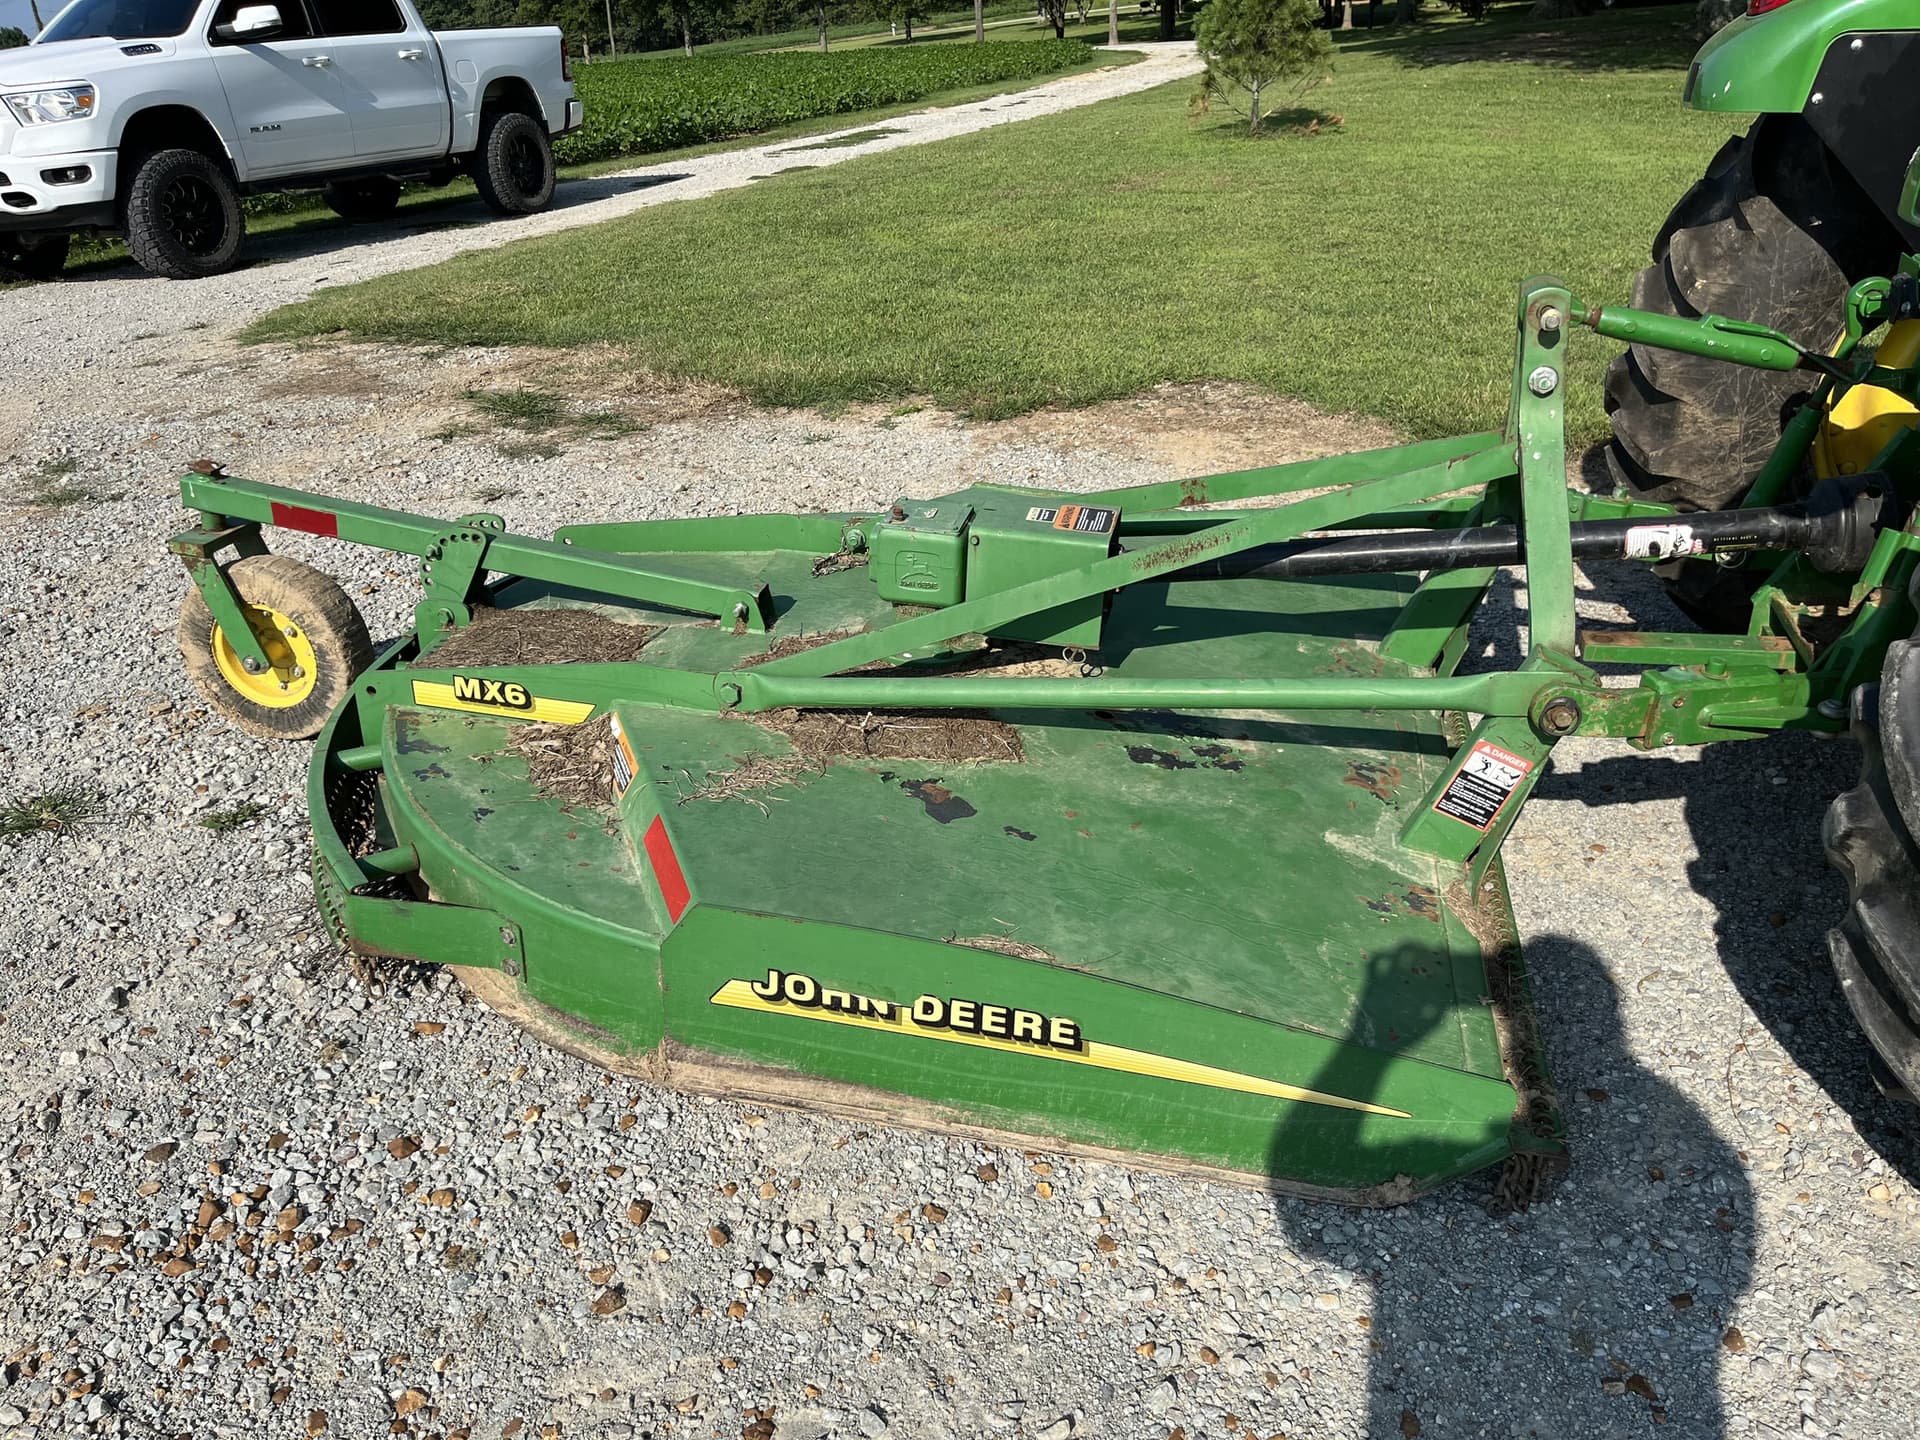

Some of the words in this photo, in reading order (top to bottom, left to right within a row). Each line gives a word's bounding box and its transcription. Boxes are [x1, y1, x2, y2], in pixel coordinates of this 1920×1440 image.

[453, 675, 532, 709] MX6
[1491, 748, 1527, 769] DANGER
[911, 994, 1082, 1052] DEERE
